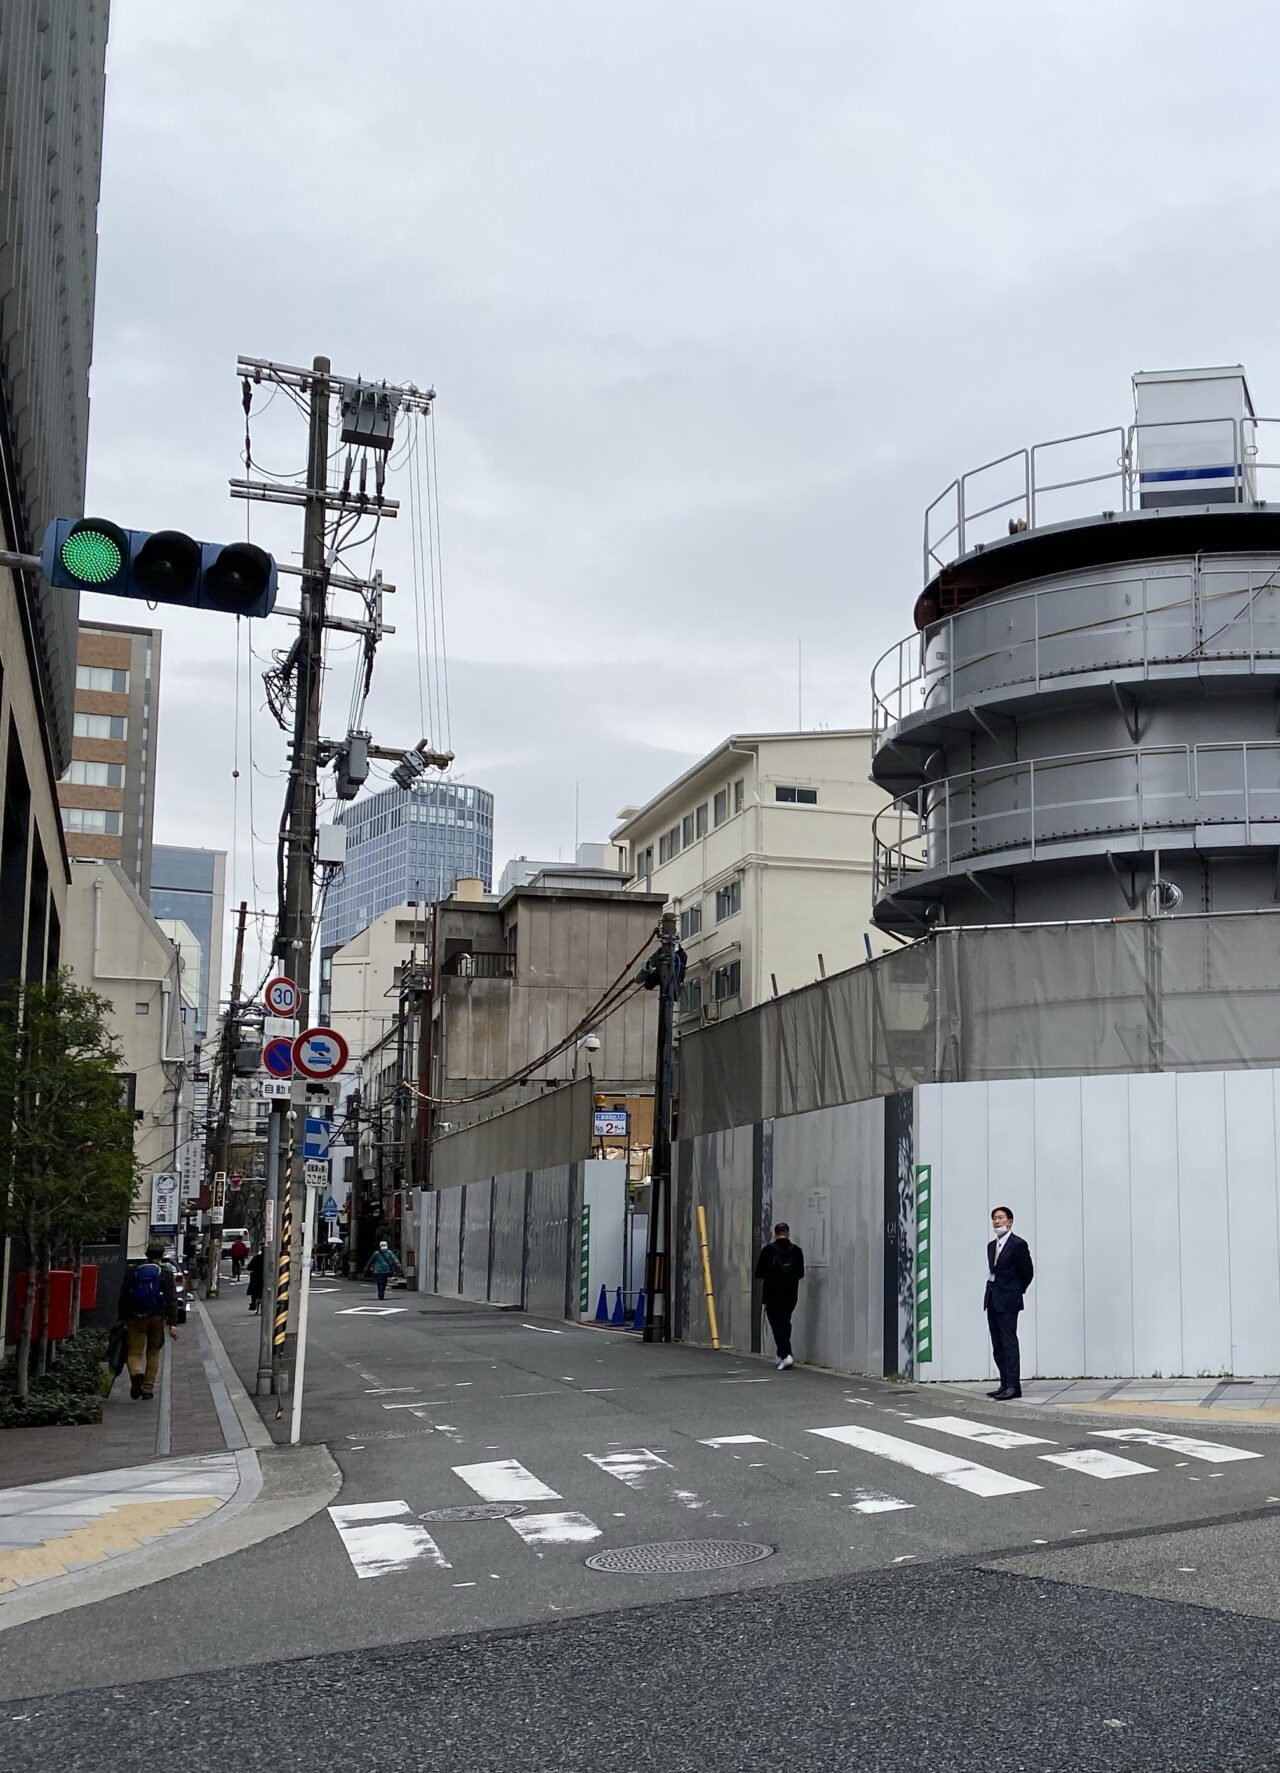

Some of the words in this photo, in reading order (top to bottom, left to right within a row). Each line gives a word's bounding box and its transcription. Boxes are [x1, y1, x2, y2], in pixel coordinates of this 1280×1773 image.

[273, 987, 294, 1006] 30
[306, 1174, 327, 1185] ここから
